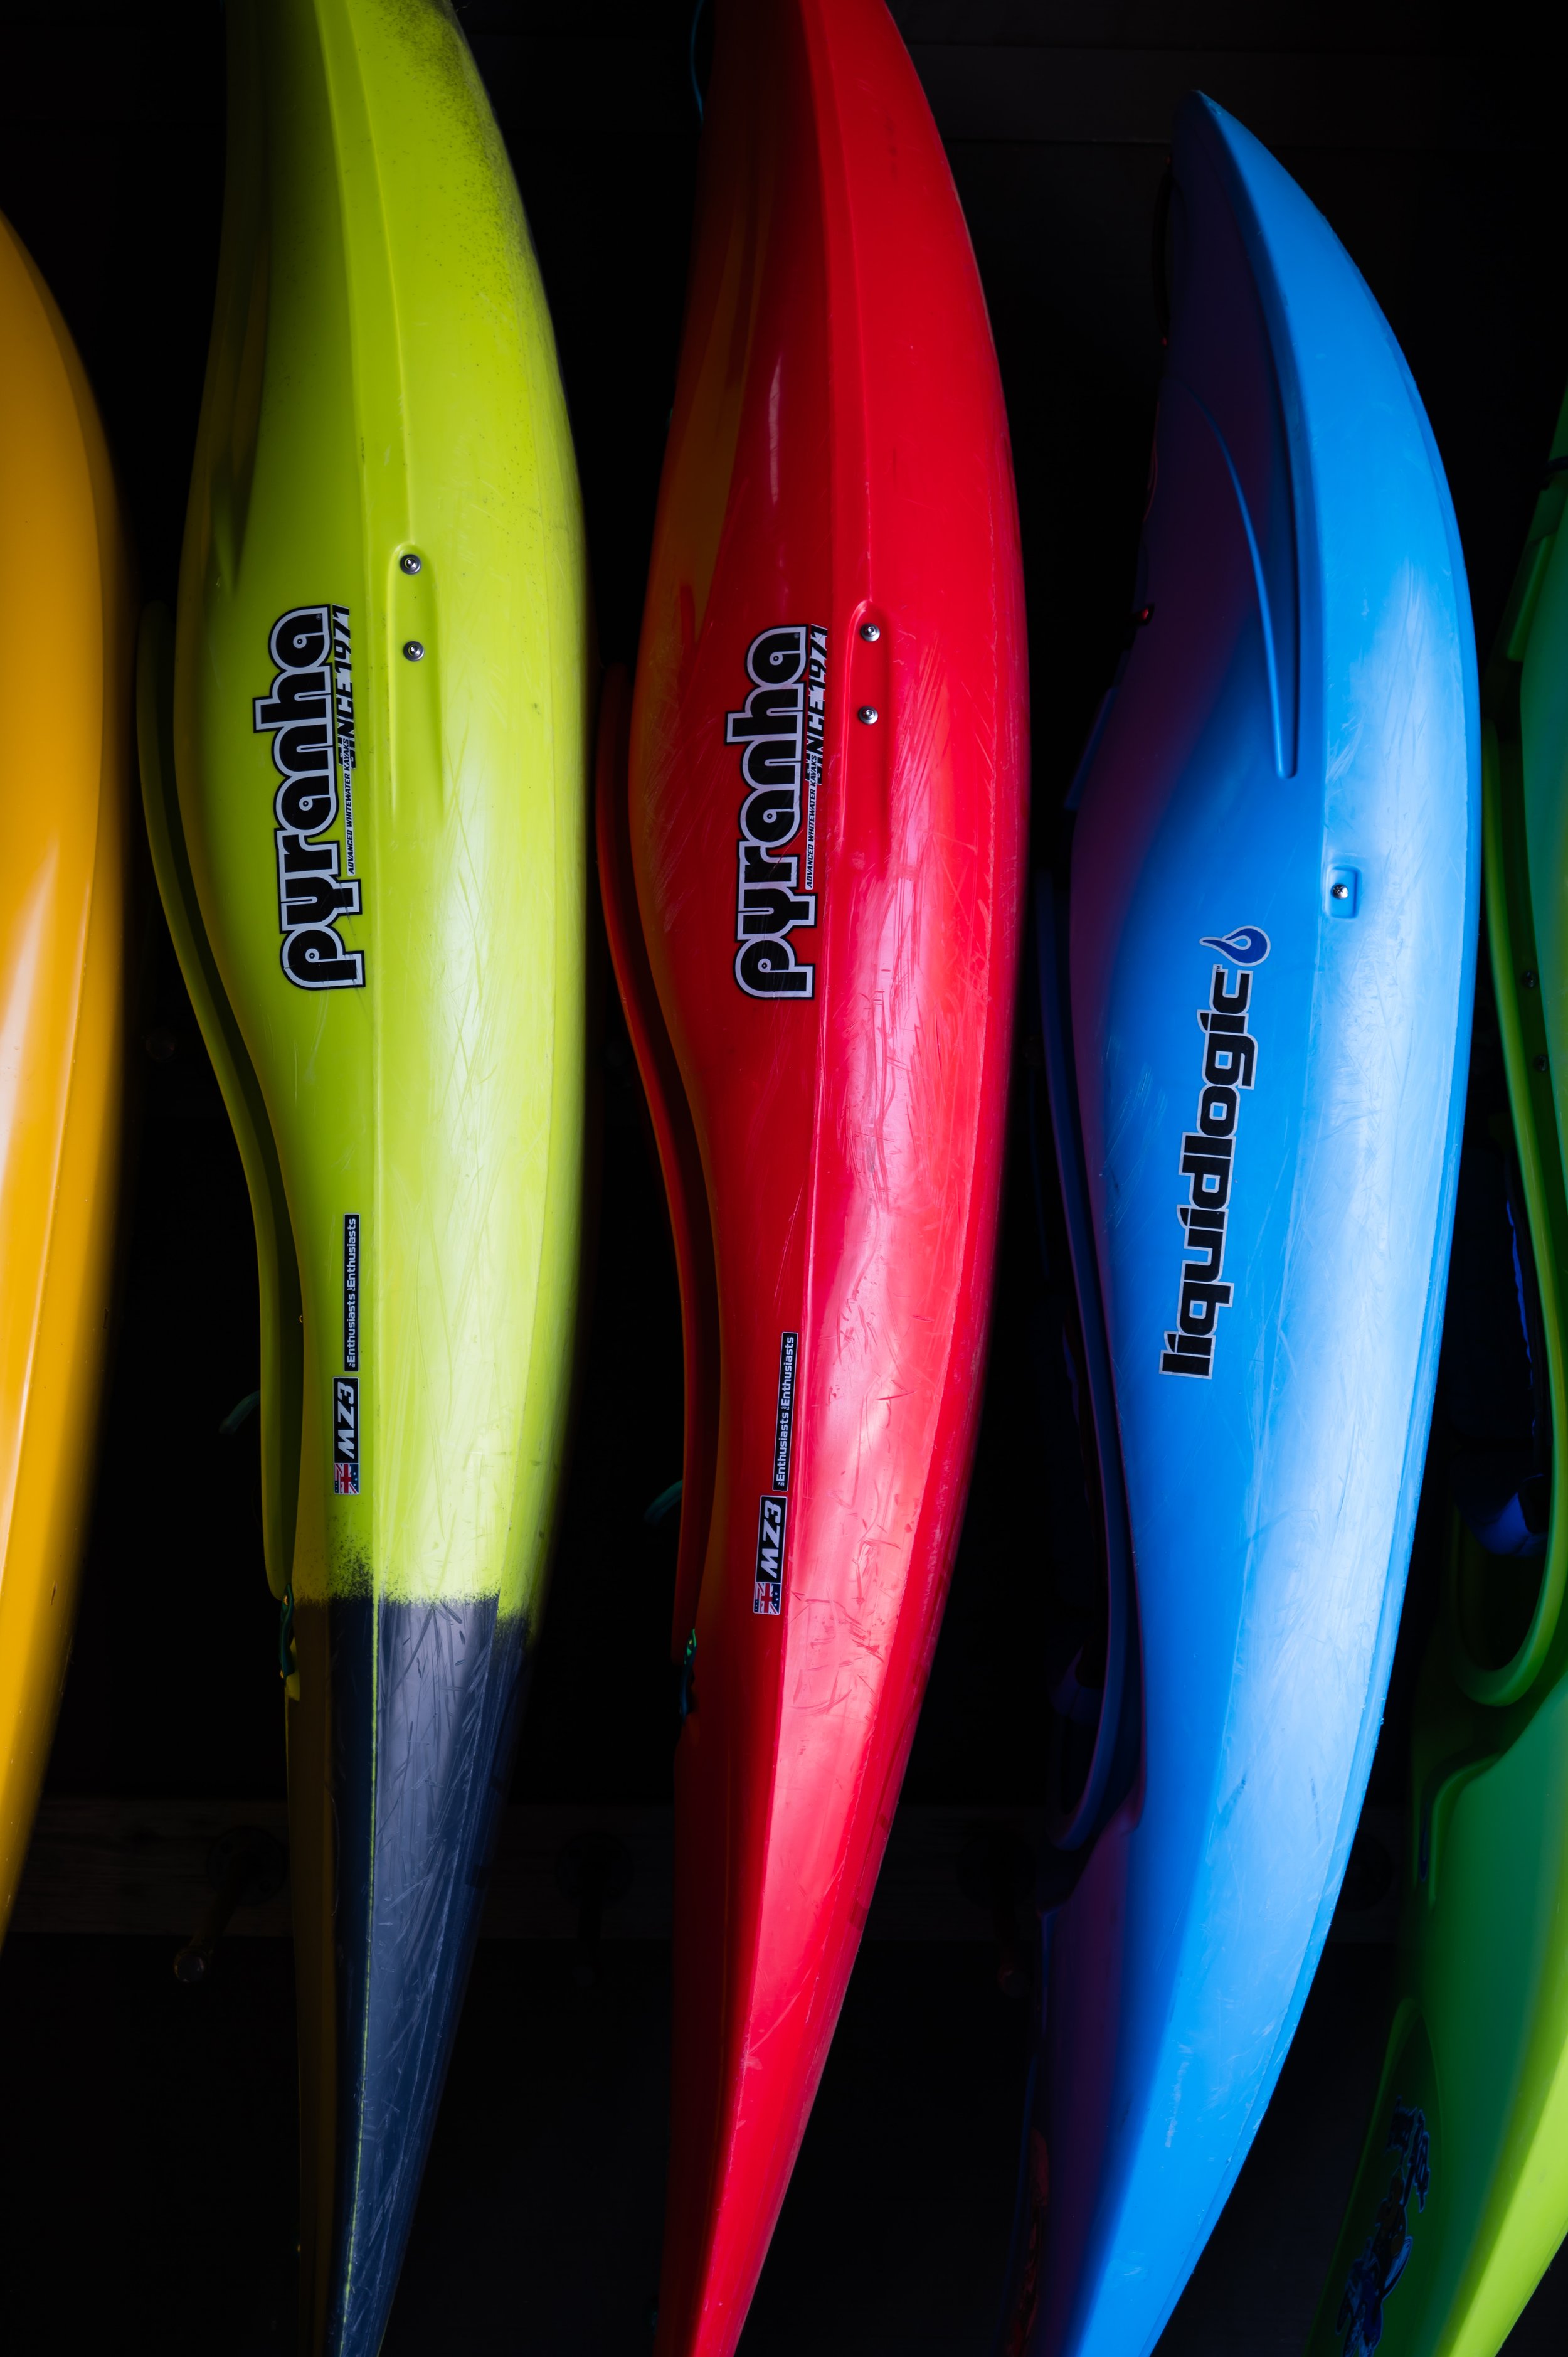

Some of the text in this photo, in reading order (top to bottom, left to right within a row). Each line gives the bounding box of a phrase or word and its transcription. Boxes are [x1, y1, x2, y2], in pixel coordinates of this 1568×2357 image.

[332, 604, 351, 673] 1971
[809, 624, 828, 691] 1971
[1160, 966, 1258, 1378] liquidlogic
[346, 1218, 356, 1287] Enthusiasts
[347, 1294, 356, 1363] Enthusiasts
[781, 1338, 793, 1406] Enthusiasts
[337, 1381, 354, 1459] MZ3
[776, 1413, 789, 1482] Enthusiasts
[761, 1499, 781, 1578] MZ3
